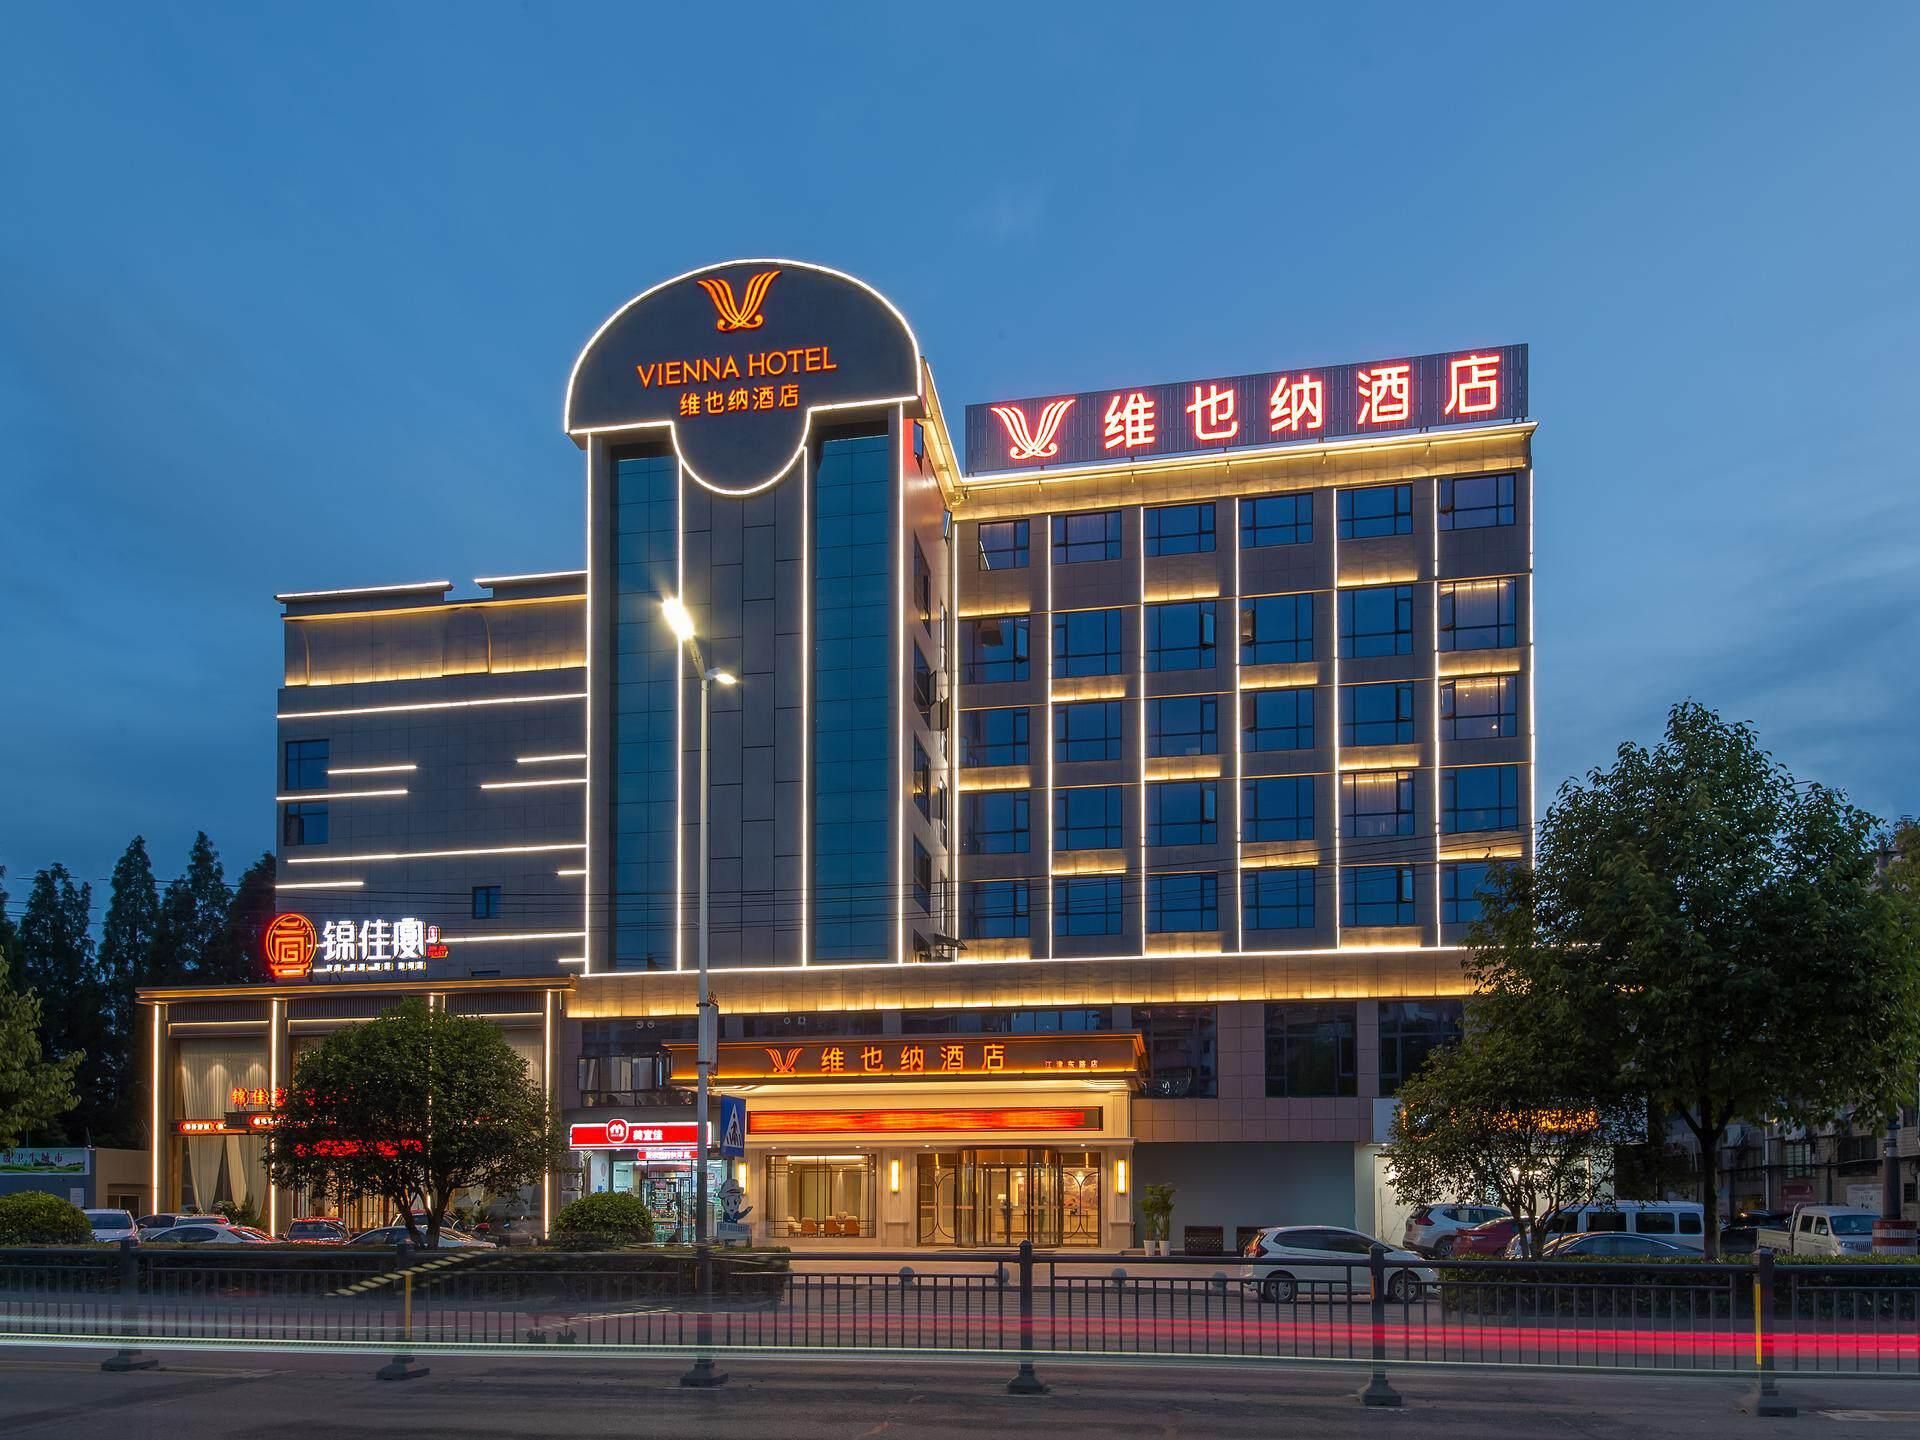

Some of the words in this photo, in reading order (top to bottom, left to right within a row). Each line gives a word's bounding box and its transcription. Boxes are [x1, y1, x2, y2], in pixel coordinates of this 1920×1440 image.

[636, 354, 741, 388] VIENNA
[747, 345, 837, 377] HOTEL
[679, 383, 800, 417] 维也纳酒店
[1104, 354, 1502, 451] 维也纳酒店
[820, 1043, 1005, 1073] 维也纳酒店
